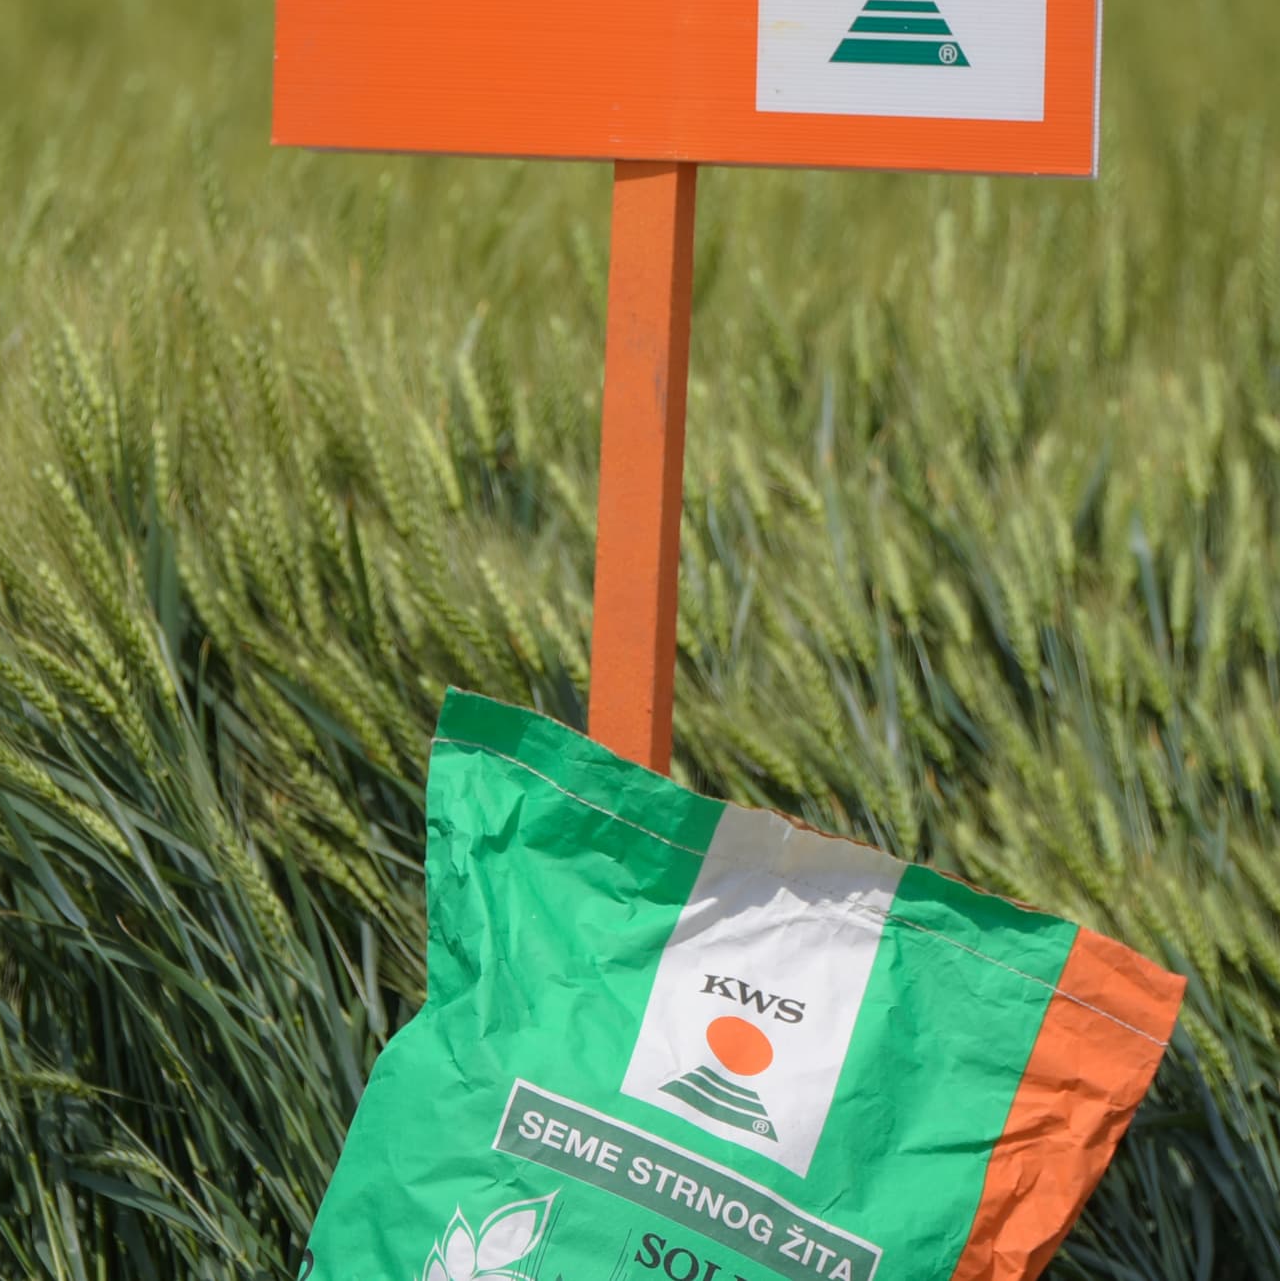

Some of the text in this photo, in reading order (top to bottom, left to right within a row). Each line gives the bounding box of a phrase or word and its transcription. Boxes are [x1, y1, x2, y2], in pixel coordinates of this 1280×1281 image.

[699, 974, 806, 1024] KWS
[518, 1110, 852, 1281] SEME STRNOG ŽITA
